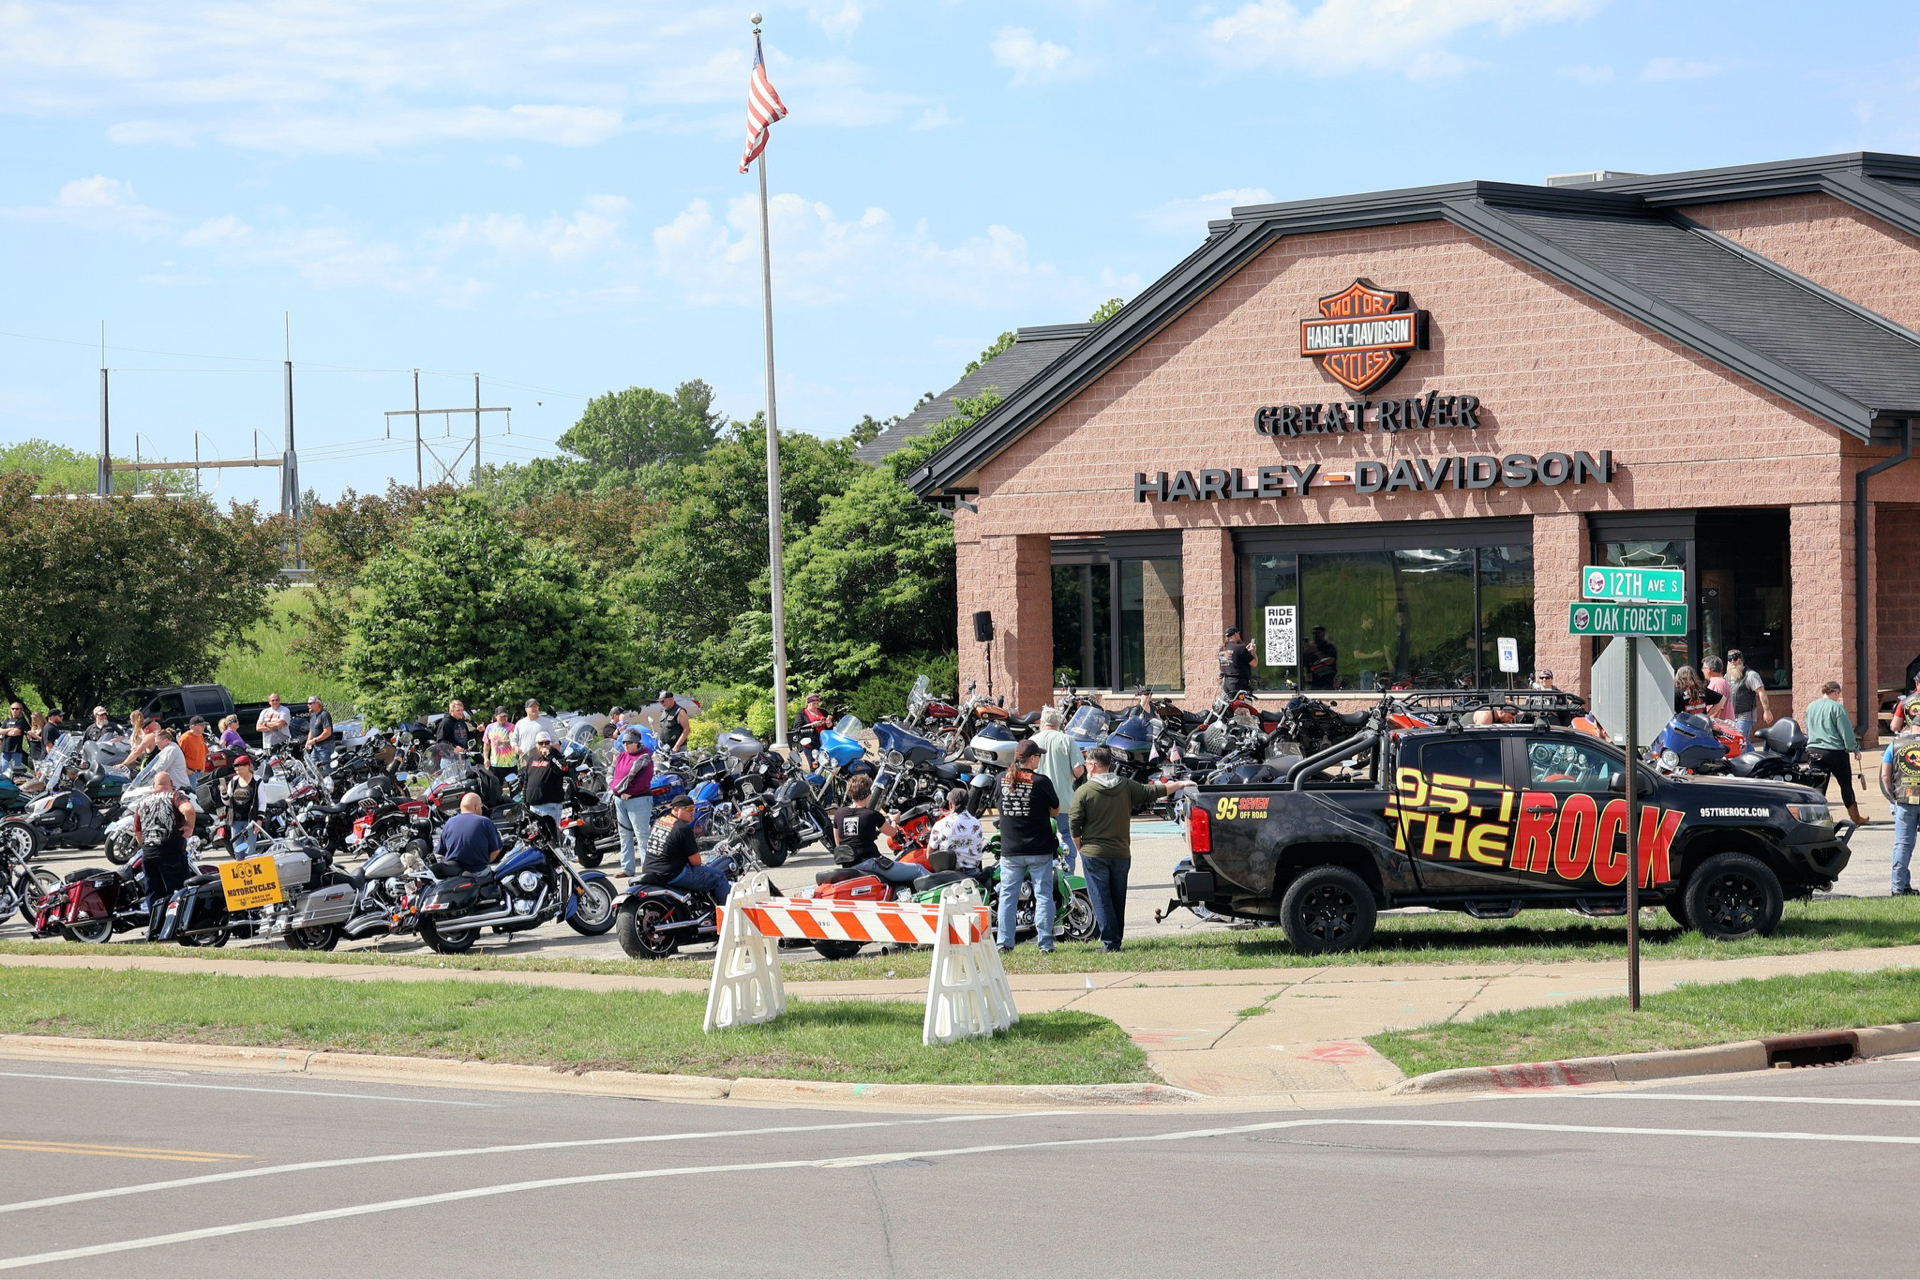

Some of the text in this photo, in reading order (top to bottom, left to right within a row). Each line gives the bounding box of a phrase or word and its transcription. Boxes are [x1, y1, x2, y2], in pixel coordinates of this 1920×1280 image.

[1330, 289, 1386, 318] MOTOR
[1306, 318, 1410, 350] HARLEY-DAVIDSON
[1331, 351, 1385, 384] CYCLES
[1254, 389, 1480, 438] GREAT RIVER
[1609, 571, 1679, 597] 12TH AVE S
[1267, 608, 1293, 617] RIDE
[1268, 617, 1293, 626] MAP
[1594, 607, 1682, 632] OAK FOREST DR
[1388, 766, 1516, 824] 95.7
[1215, 796, 1270, 821] 95 SEVEN
[1239, 811, 1268, 819] OFF ROAD
[1699, 807, 1770, 818] 957THEROCK.COM
[1384, 791, 1686, 890] THE ROCK
[231, 862, 263, 879] LOOK
[227, 881, 277, 898] MOTORCYCLES
